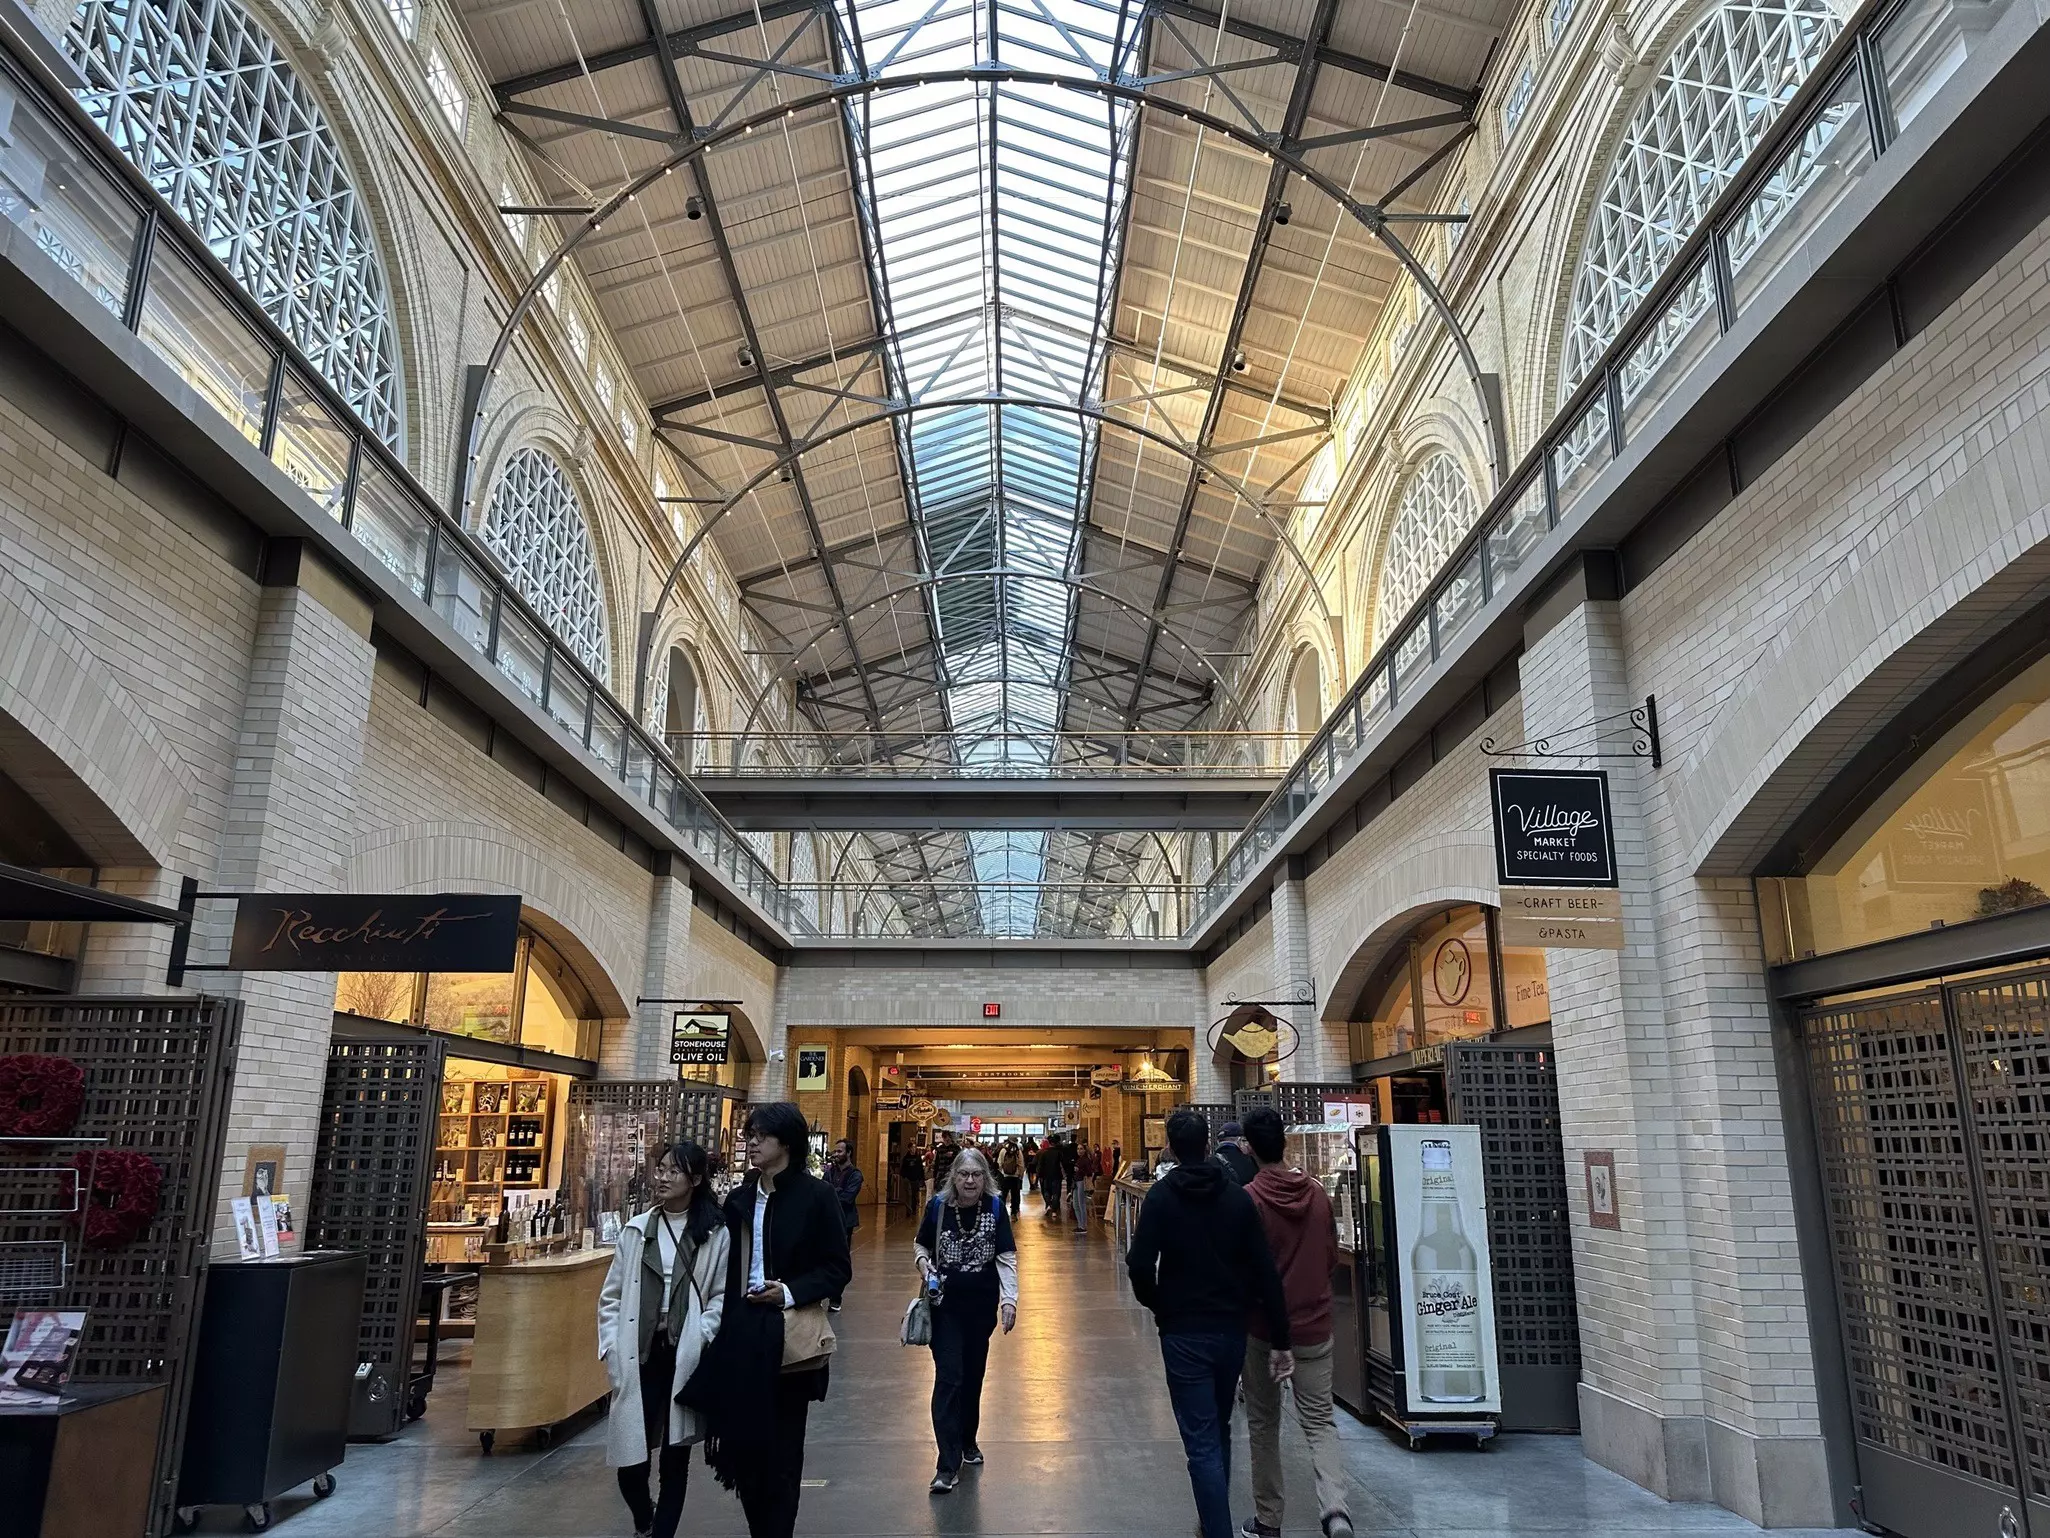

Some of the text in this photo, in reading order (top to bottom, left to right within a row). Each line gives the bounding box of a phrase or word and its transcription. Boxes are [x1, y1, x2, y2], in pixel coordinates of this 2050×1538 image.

[1507, 804, 1599, 837] Village
[1533, 837, 1577, 848] MARKET
[1516, 850, 1599, 863] SPECIALTY FOODS
[261, 908, 494, 956] Recchiuti
[1538, 926, 1587, 939] &PASTA
[1515, 984, 1531, 1002] Fine
[985, 1004, 998, 1016] EXIT
[674, 1040, 727, 1048] STONEHOUSE
[672, 1052, 725, 1062] OLIVE OIL
[1411, 1045, 1443, 1068] IMPERIAL
[1142, 1083, 1182, 1091] MERCHANT
[1421, 1173, 1455, 1187] Original
[1422, 1291, 1441, 1299] Bruce
[1416, 1295, 1478, 1317] Ginger Ale
[1424, 1341, 1457, 1353] Original
